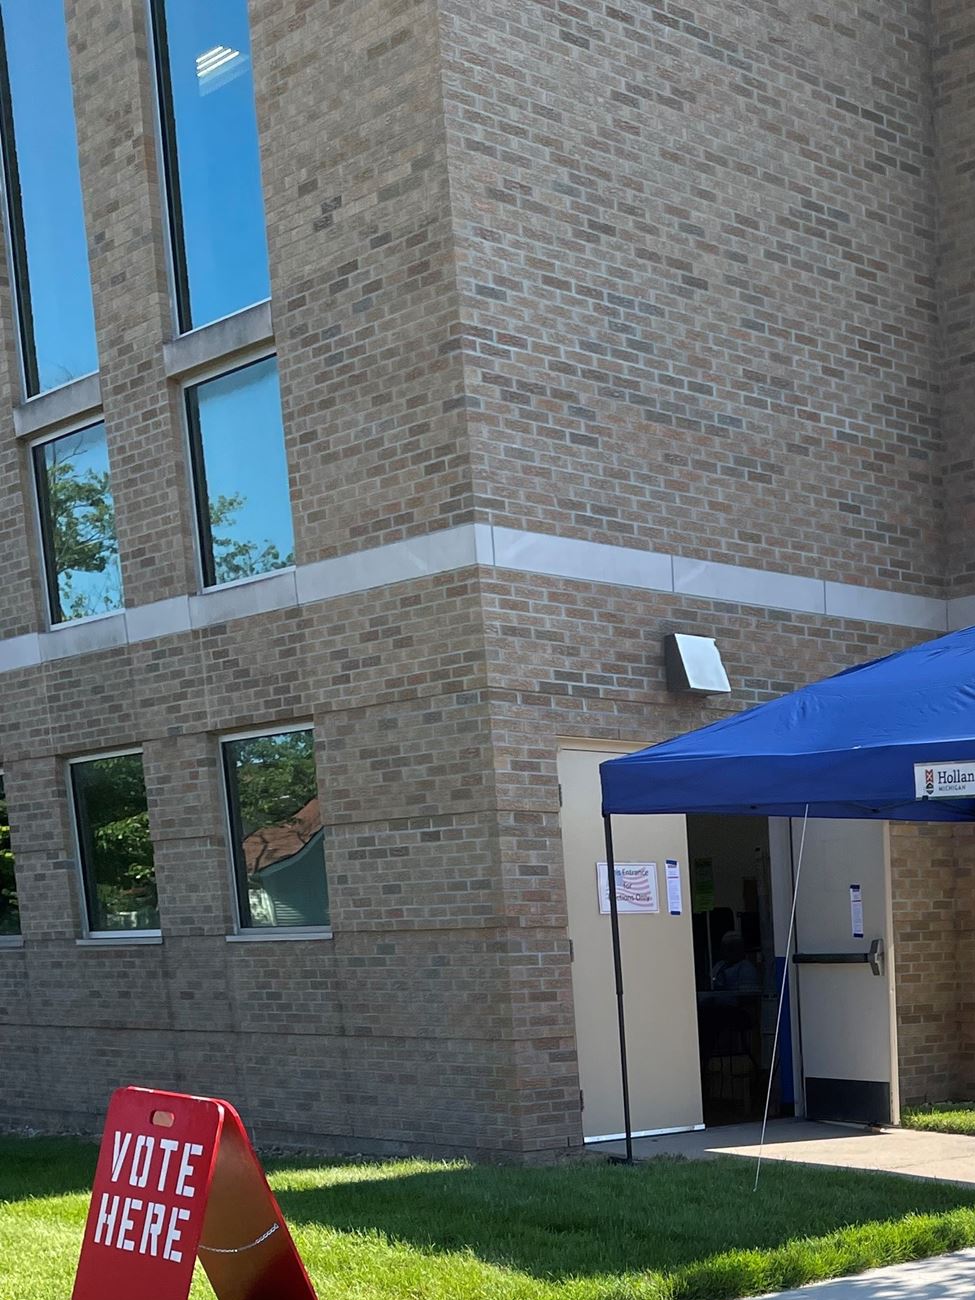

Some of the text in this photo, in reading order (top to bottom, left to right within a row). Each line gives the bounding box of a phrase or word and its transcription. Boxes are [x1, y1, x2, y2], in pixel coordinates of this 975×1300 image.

[938, 784, 966, 792] MICHIGAN
[622, 868, 649, 877] Entrance
[111, 1130, 204, 1198] VOTE
[93, 1192, 191, 1264] HERE
